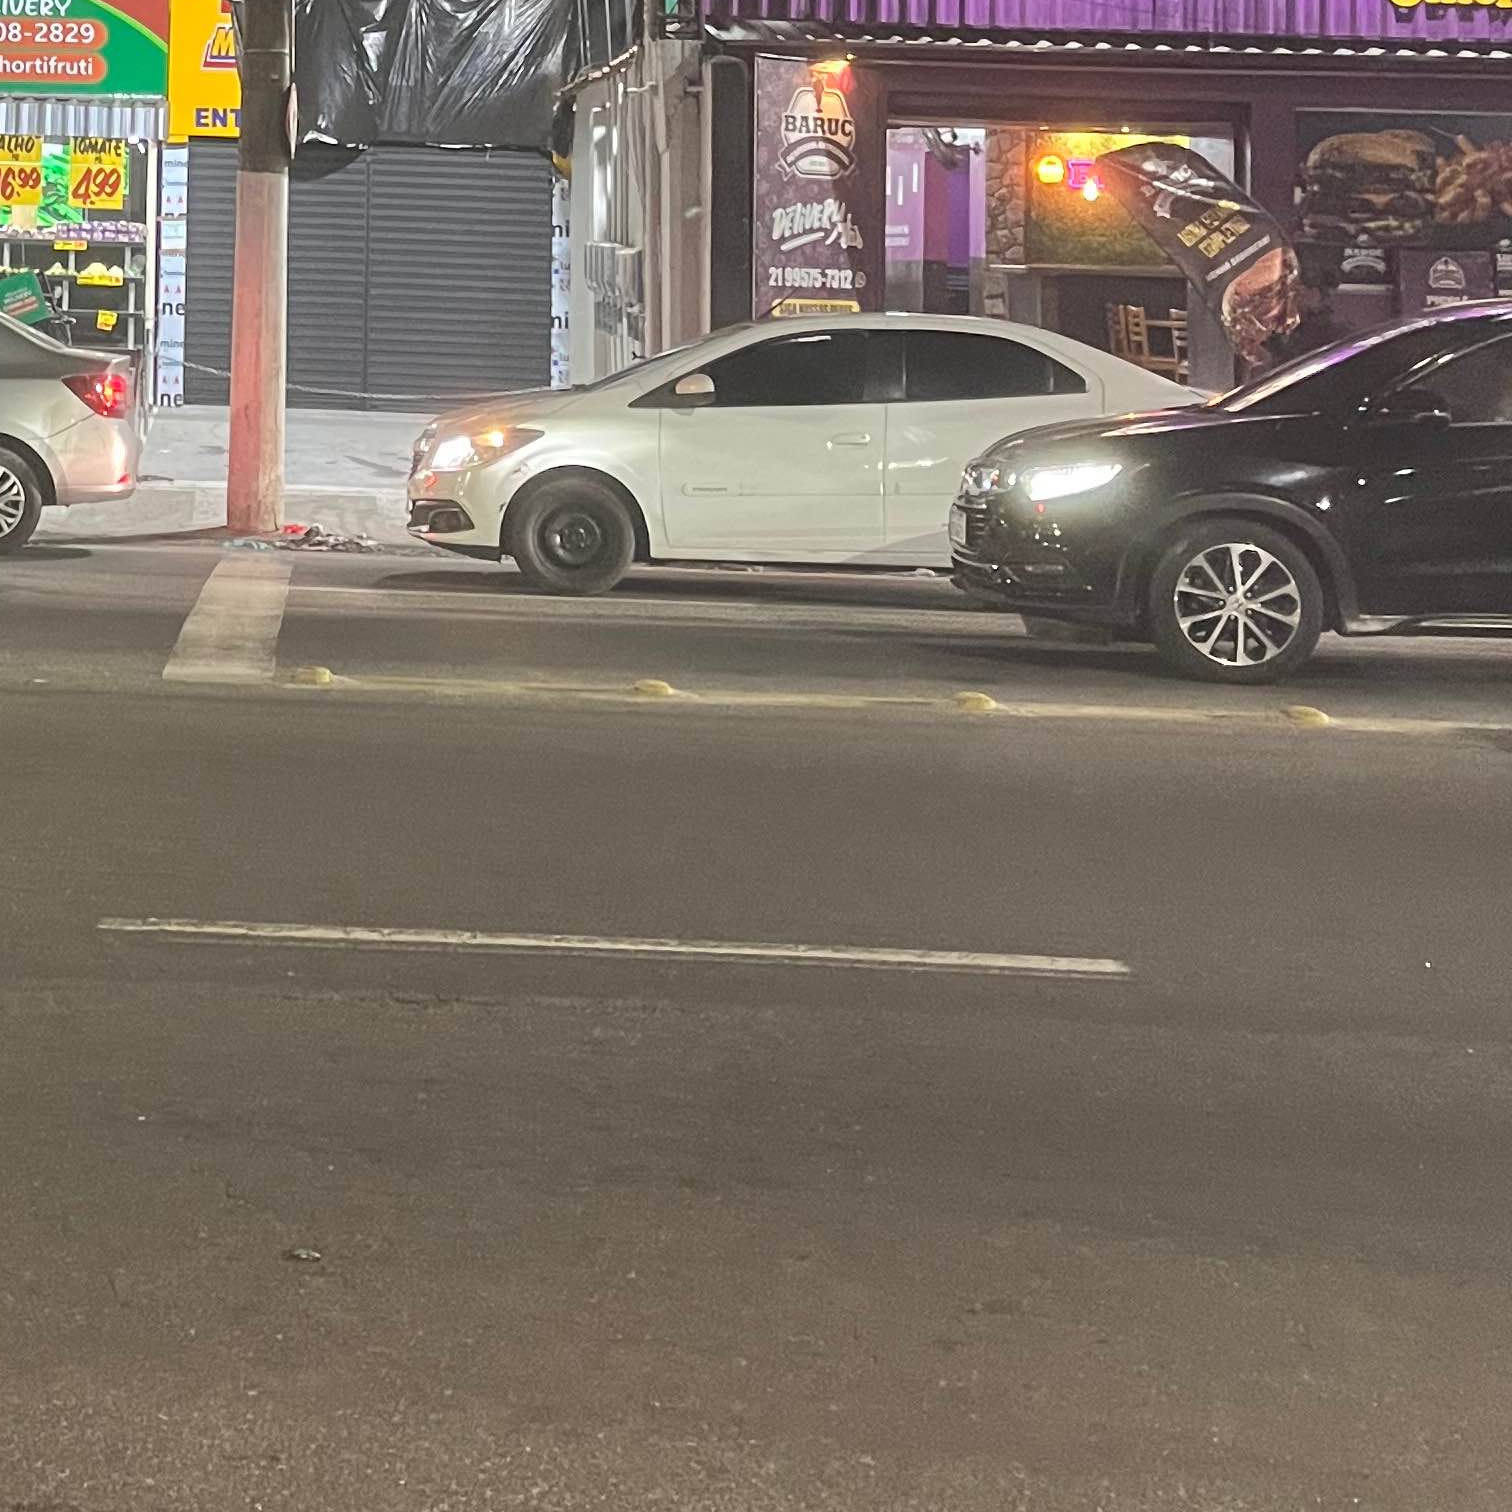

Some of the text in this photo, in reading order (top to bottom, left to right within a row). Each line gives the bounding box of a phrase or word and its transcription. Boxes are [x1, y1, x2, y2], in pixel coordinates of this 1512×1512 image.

[784, 114, 855, 136] BARUC
[73, 138, 122, 157] TOMATE
[71, 166, 122, 205] 4.99
[769, 267, 783, 286] 21
